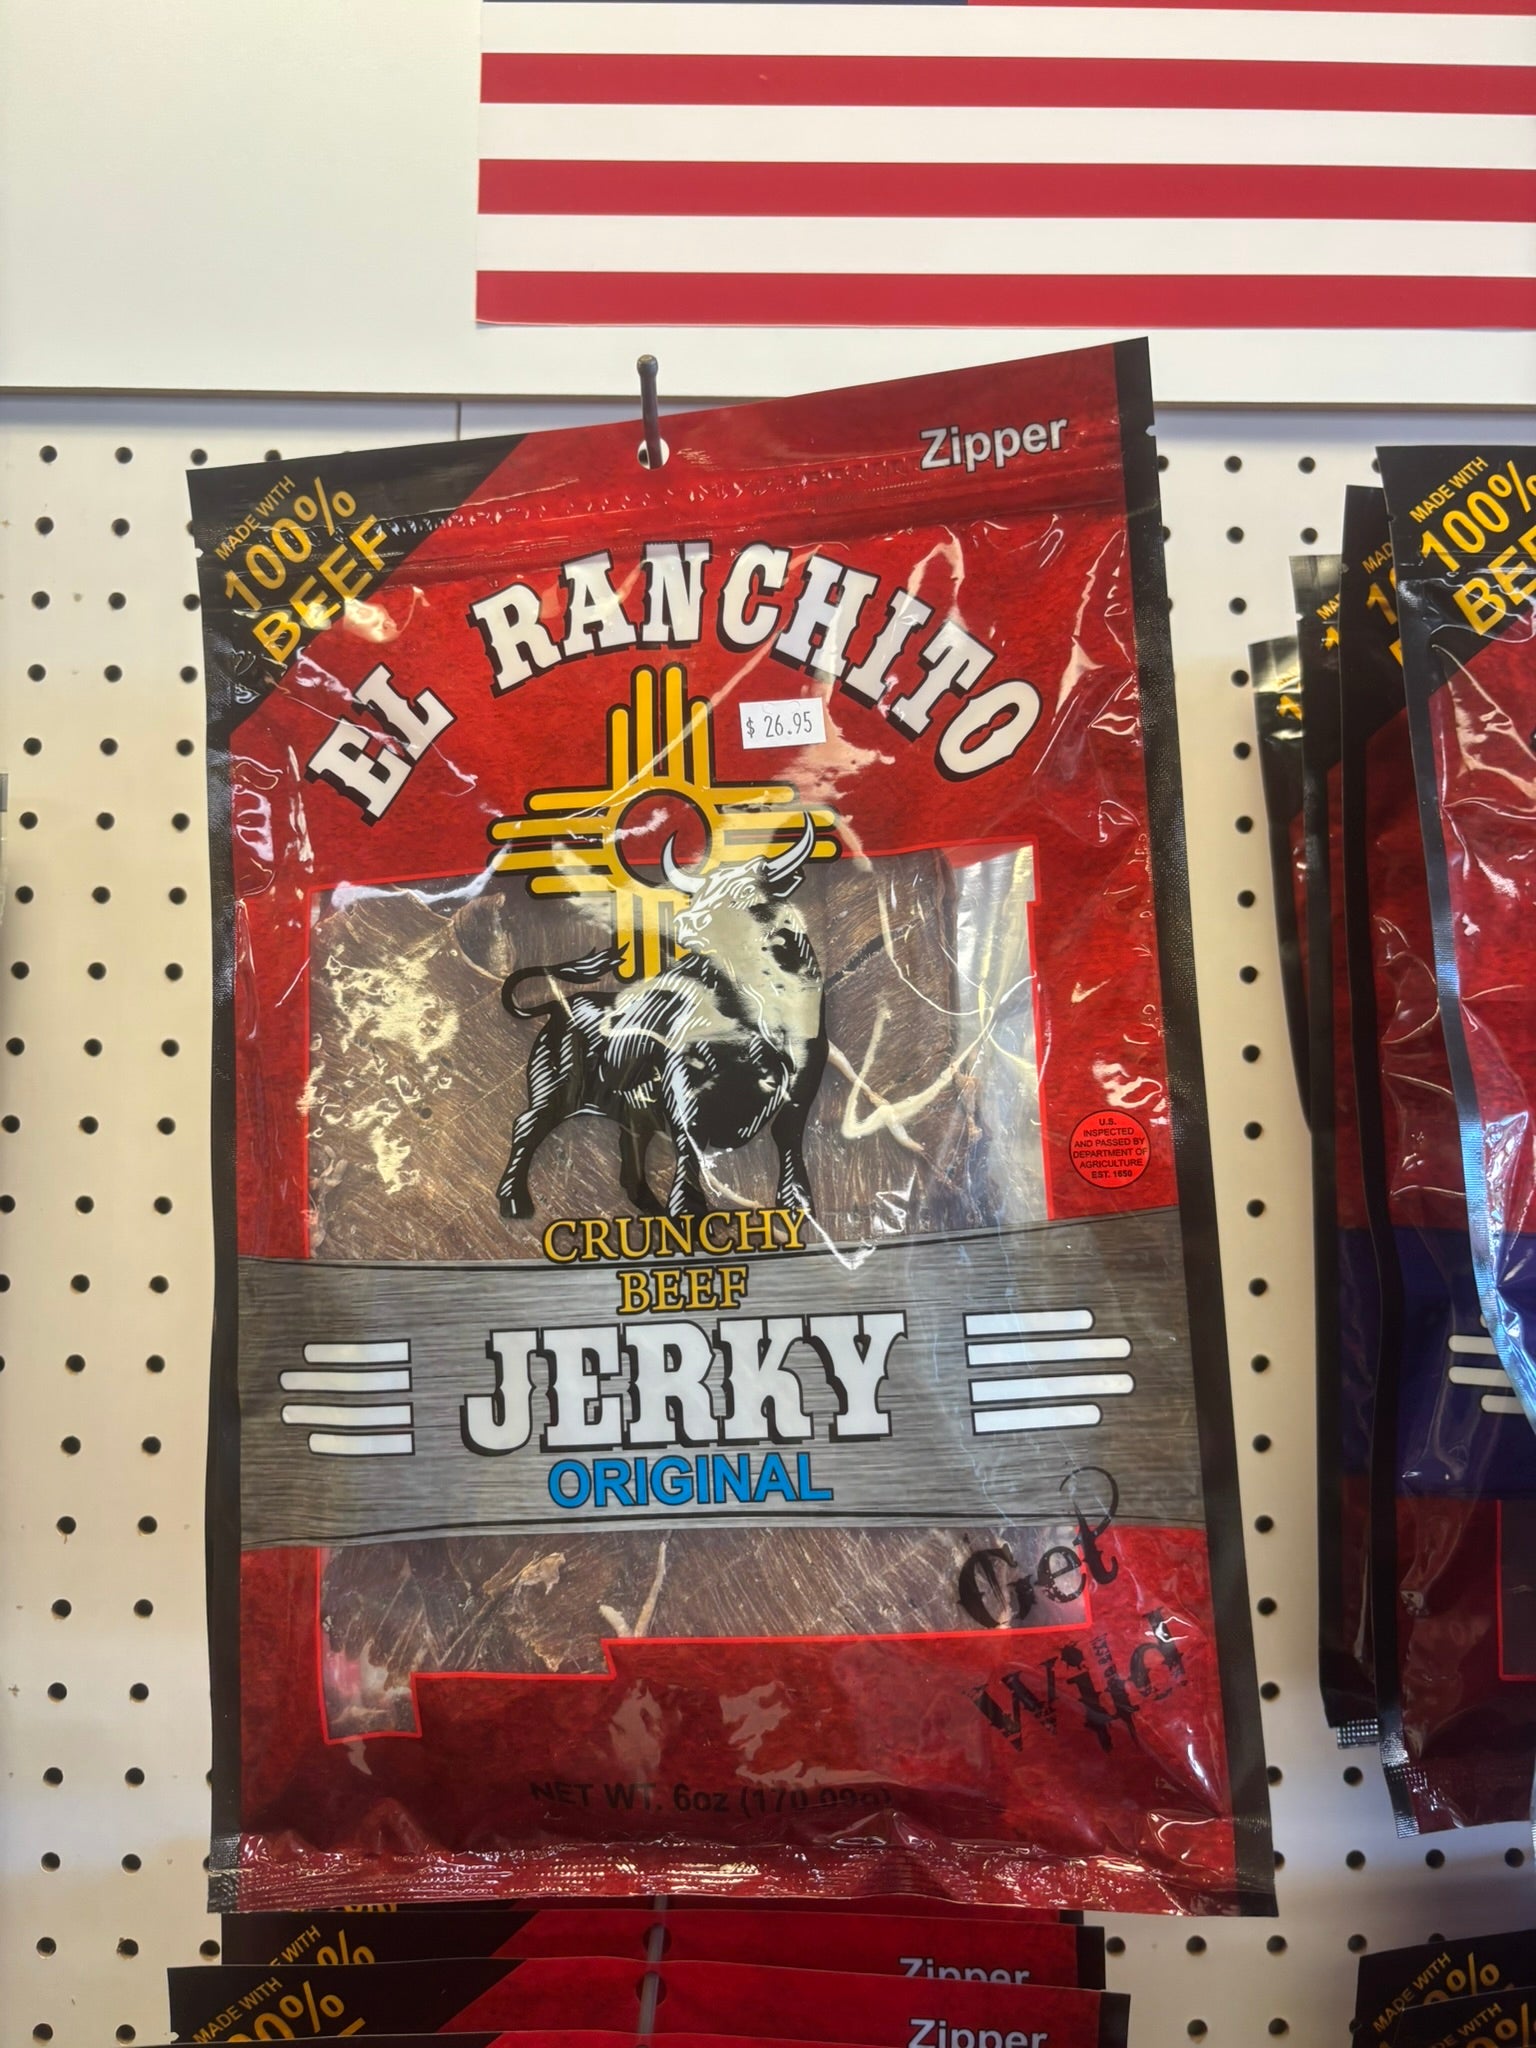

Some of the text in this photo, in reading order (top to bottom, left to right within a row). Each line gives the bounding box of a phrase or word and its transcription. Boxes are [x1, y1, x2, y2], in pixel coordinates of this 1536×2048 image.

[920, 419, 1069, 473] Zipper
[1409, 456, 1489, 523] MADE WITH
[213, 475, 296, 560] MADE WITH
[1421, 460, 1536, 572] 100%
[225, 476, 356, 611] 100%
[1362, 540, 1393, 574] MAD
[252, 514, 388, 662] BEEF
[1452, 524, 1536, 637] BE
[304, 541, 1041, 827] EL RANCHITO
[746, 711, 812, 738] $ 26.95
[1083, 1127, 1134, 1137] INSPECTED
[1095, 1138, 1130, 1147] PASSED
[1133, 1137, 1145, 1145] BY
[1099, 1118, 1117, 1126] U.S.
[1073, 1147, 1147, 1158] DEPARTMENT OF
[1080, 1158, 1143, 1168] AGRICULTURE
[542, 1207, 810, 1263] CRUNCHY
[616, 1265, 749, 1315] BEEF
[459, 1310, 908, 1456] JERKY
[548, 1452, 833, 1508] ORIGINAL
[957, 1466, 1119, 1629] Get
[530, 1782, 593, 1807] NET
[604, 1783, 662, 1811] WT.
[673, 1783, 728, 1813] 6oz
[281, 1925, 321, 1963] WITH
[1412, 1951, 1451, 1991] WITH
[192, 1976, 283, 2044] MADE WITH
[909, 2018, 1048, 2048] Zipper
[1457, 2002, 1502, 2037] WITH
